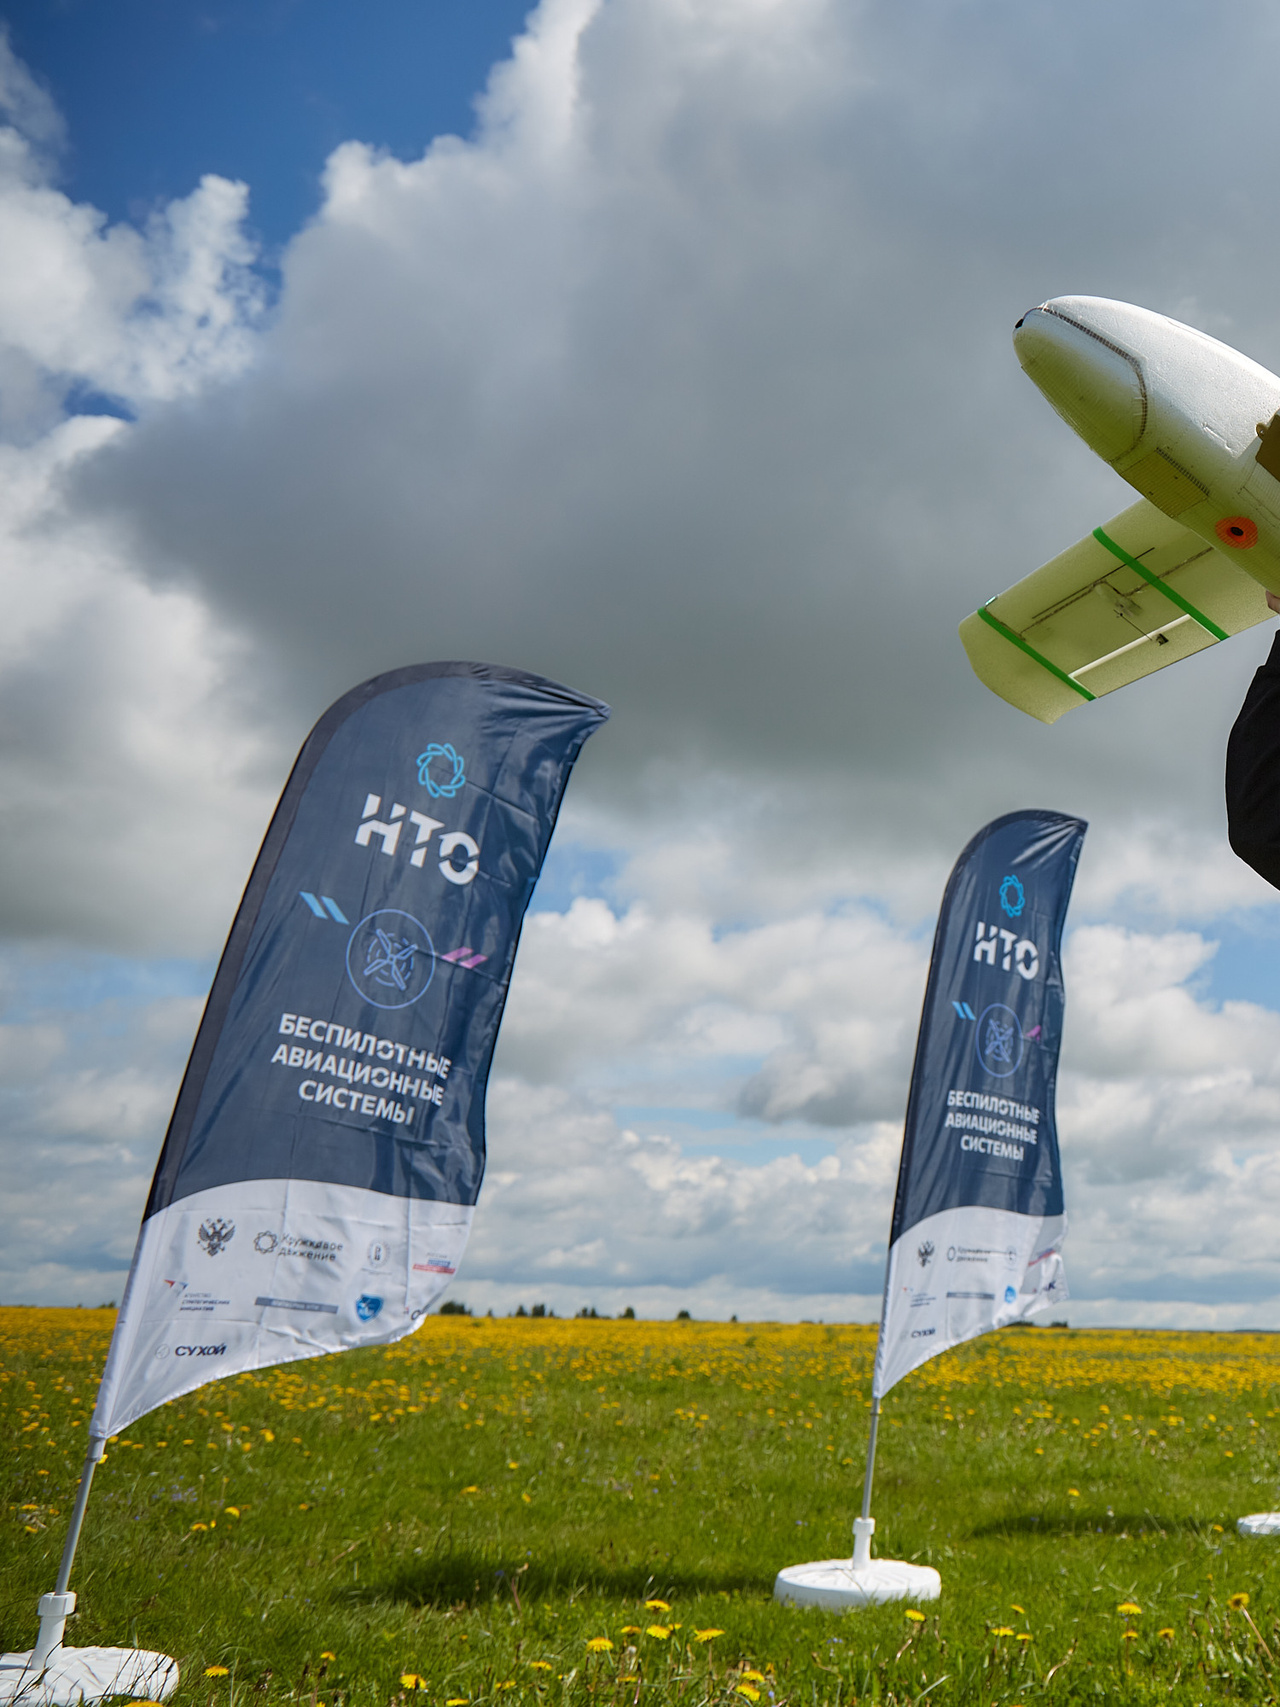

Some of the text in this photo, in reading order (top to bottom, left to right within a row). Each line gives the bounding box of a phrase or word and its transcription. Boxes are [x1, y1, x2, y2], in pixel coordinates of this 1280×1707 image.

[355, 793, 480, 885] НТО
[973, 921, 1039, 980] НТО
[278, 1013, 452, 1080] БЕСПИЛОТНЫЕ
[270, 1043, 446, 1107] АВИАЦИОННЫЕ
[298, 1079, 417, 1126] СИСТЕМЫ
[947, 1089, 1041, 1125] БЕСПИЛОТНЫЕ
[944, 1112, 1038, 1145] АВИАЦИОННЫЕ
[960, 1134, 1025, 1162] СИСТЕМЫ
[175, 1342, 228, 1357] СУХОЙ
